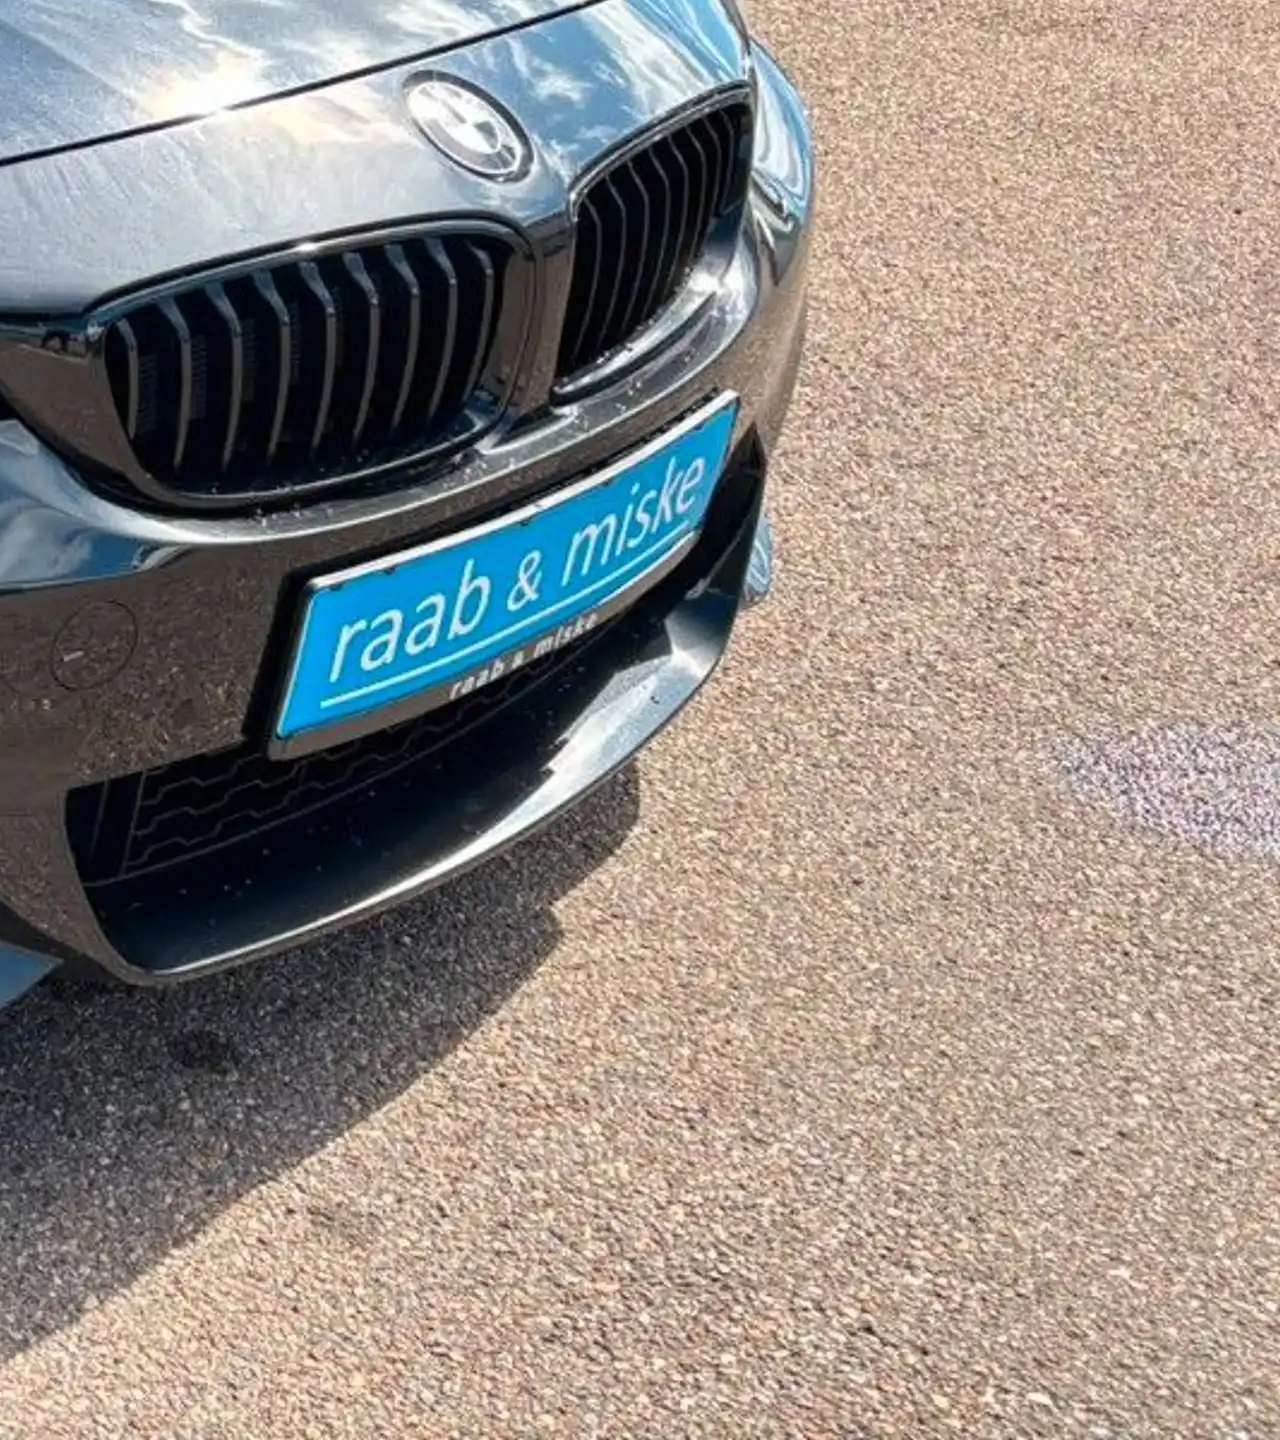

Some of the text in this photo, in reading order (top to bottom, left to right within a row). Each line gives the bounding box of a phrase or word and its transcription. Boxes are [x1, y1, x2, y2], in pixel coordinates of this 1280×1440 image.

[329, 455, 706, 683] raab & miske
[448, 656, 506, 701] raab
[532, 612, 599, 659] miske
